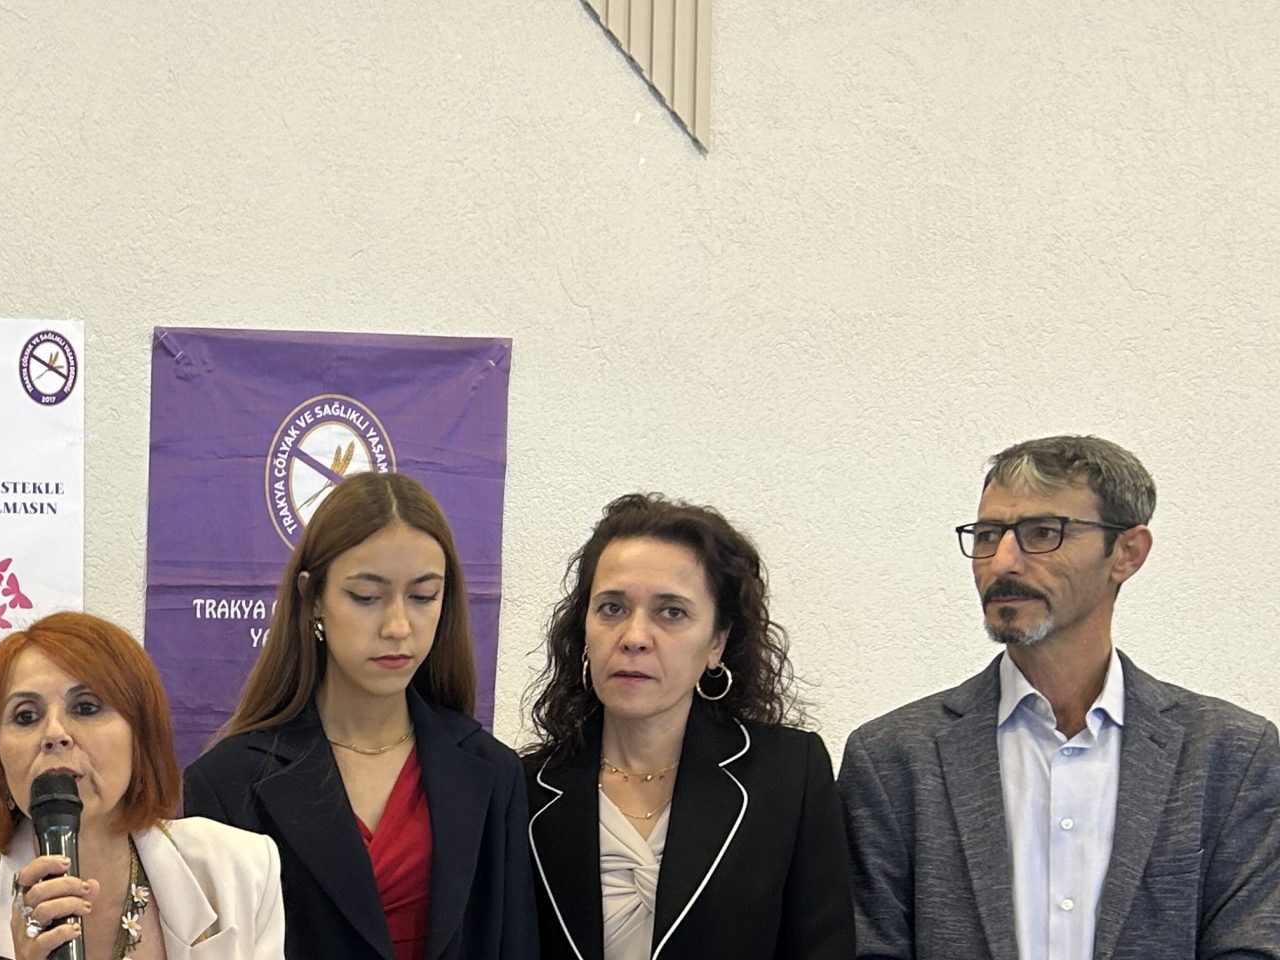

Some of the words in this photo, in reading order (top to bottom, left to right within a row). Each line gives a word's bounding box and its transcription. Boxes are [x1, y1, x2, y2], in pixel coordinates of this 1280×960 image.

[296, 410, 315, 428] VE
[314, 401, 370, 431] SAĞLIKLI
[273, 425, 300, 477] ÇÖLYAK
[366, 427, 389, 474] YAŞAM
[274, 480, 298, 535] TRAKYA
[192, 598, 266, 619] TRAKYA
